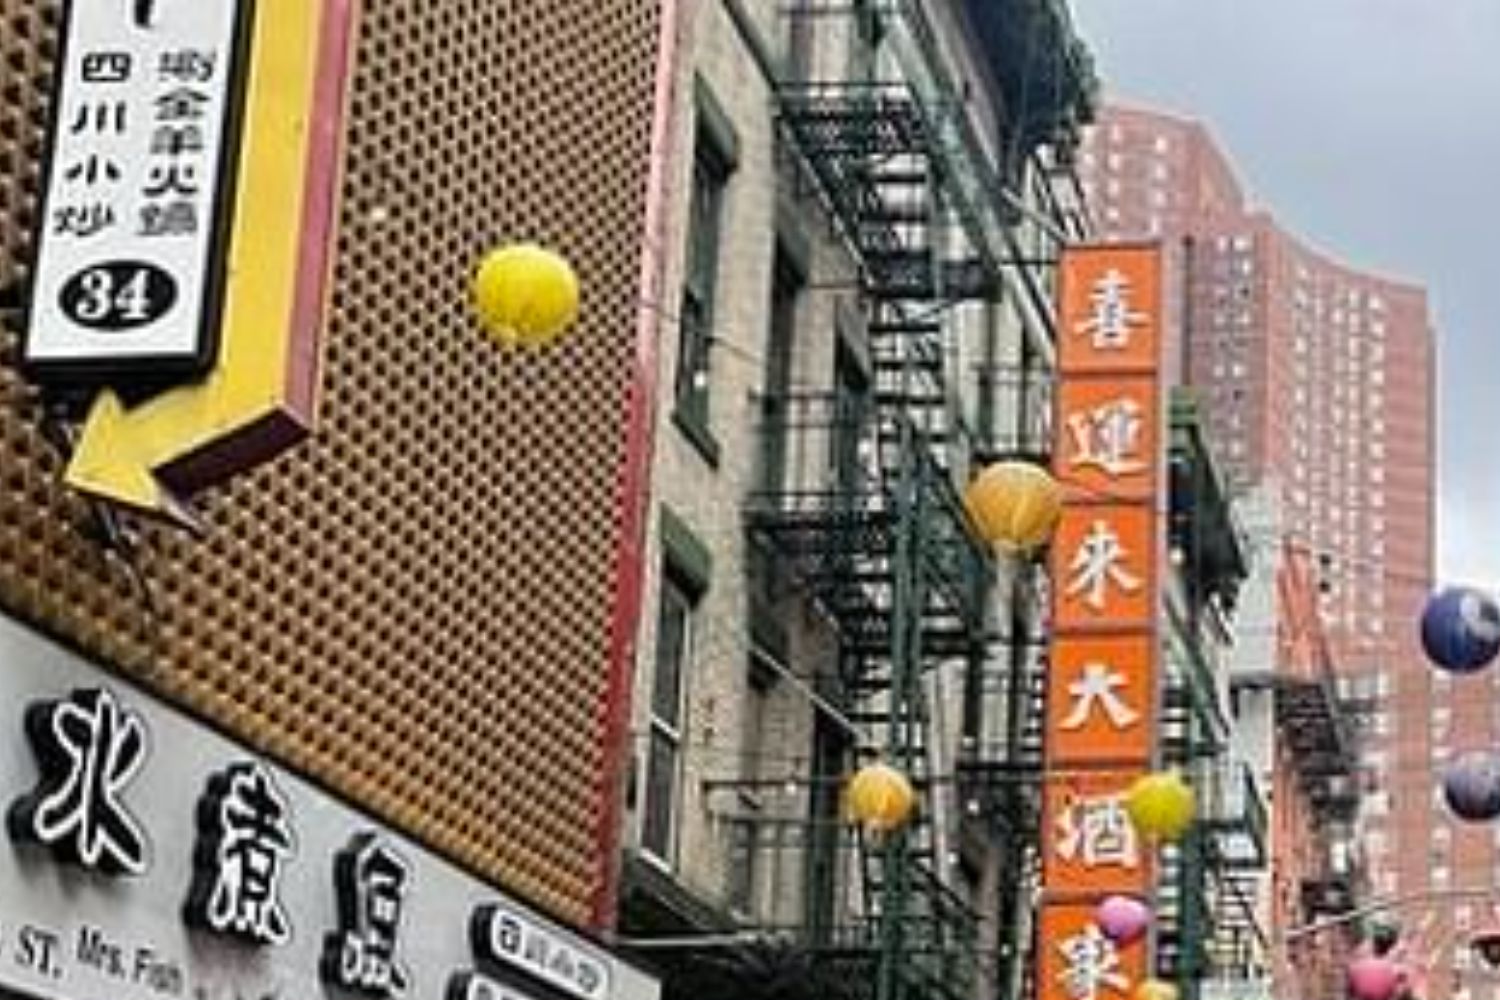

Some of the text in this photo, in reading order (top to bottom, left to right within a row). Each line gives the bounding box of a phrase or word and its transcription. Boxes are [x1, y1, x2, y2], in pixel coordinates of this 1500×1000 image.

[53, 52, 131, 237] 四川小炒
[75, 267, 153, 322] 34
